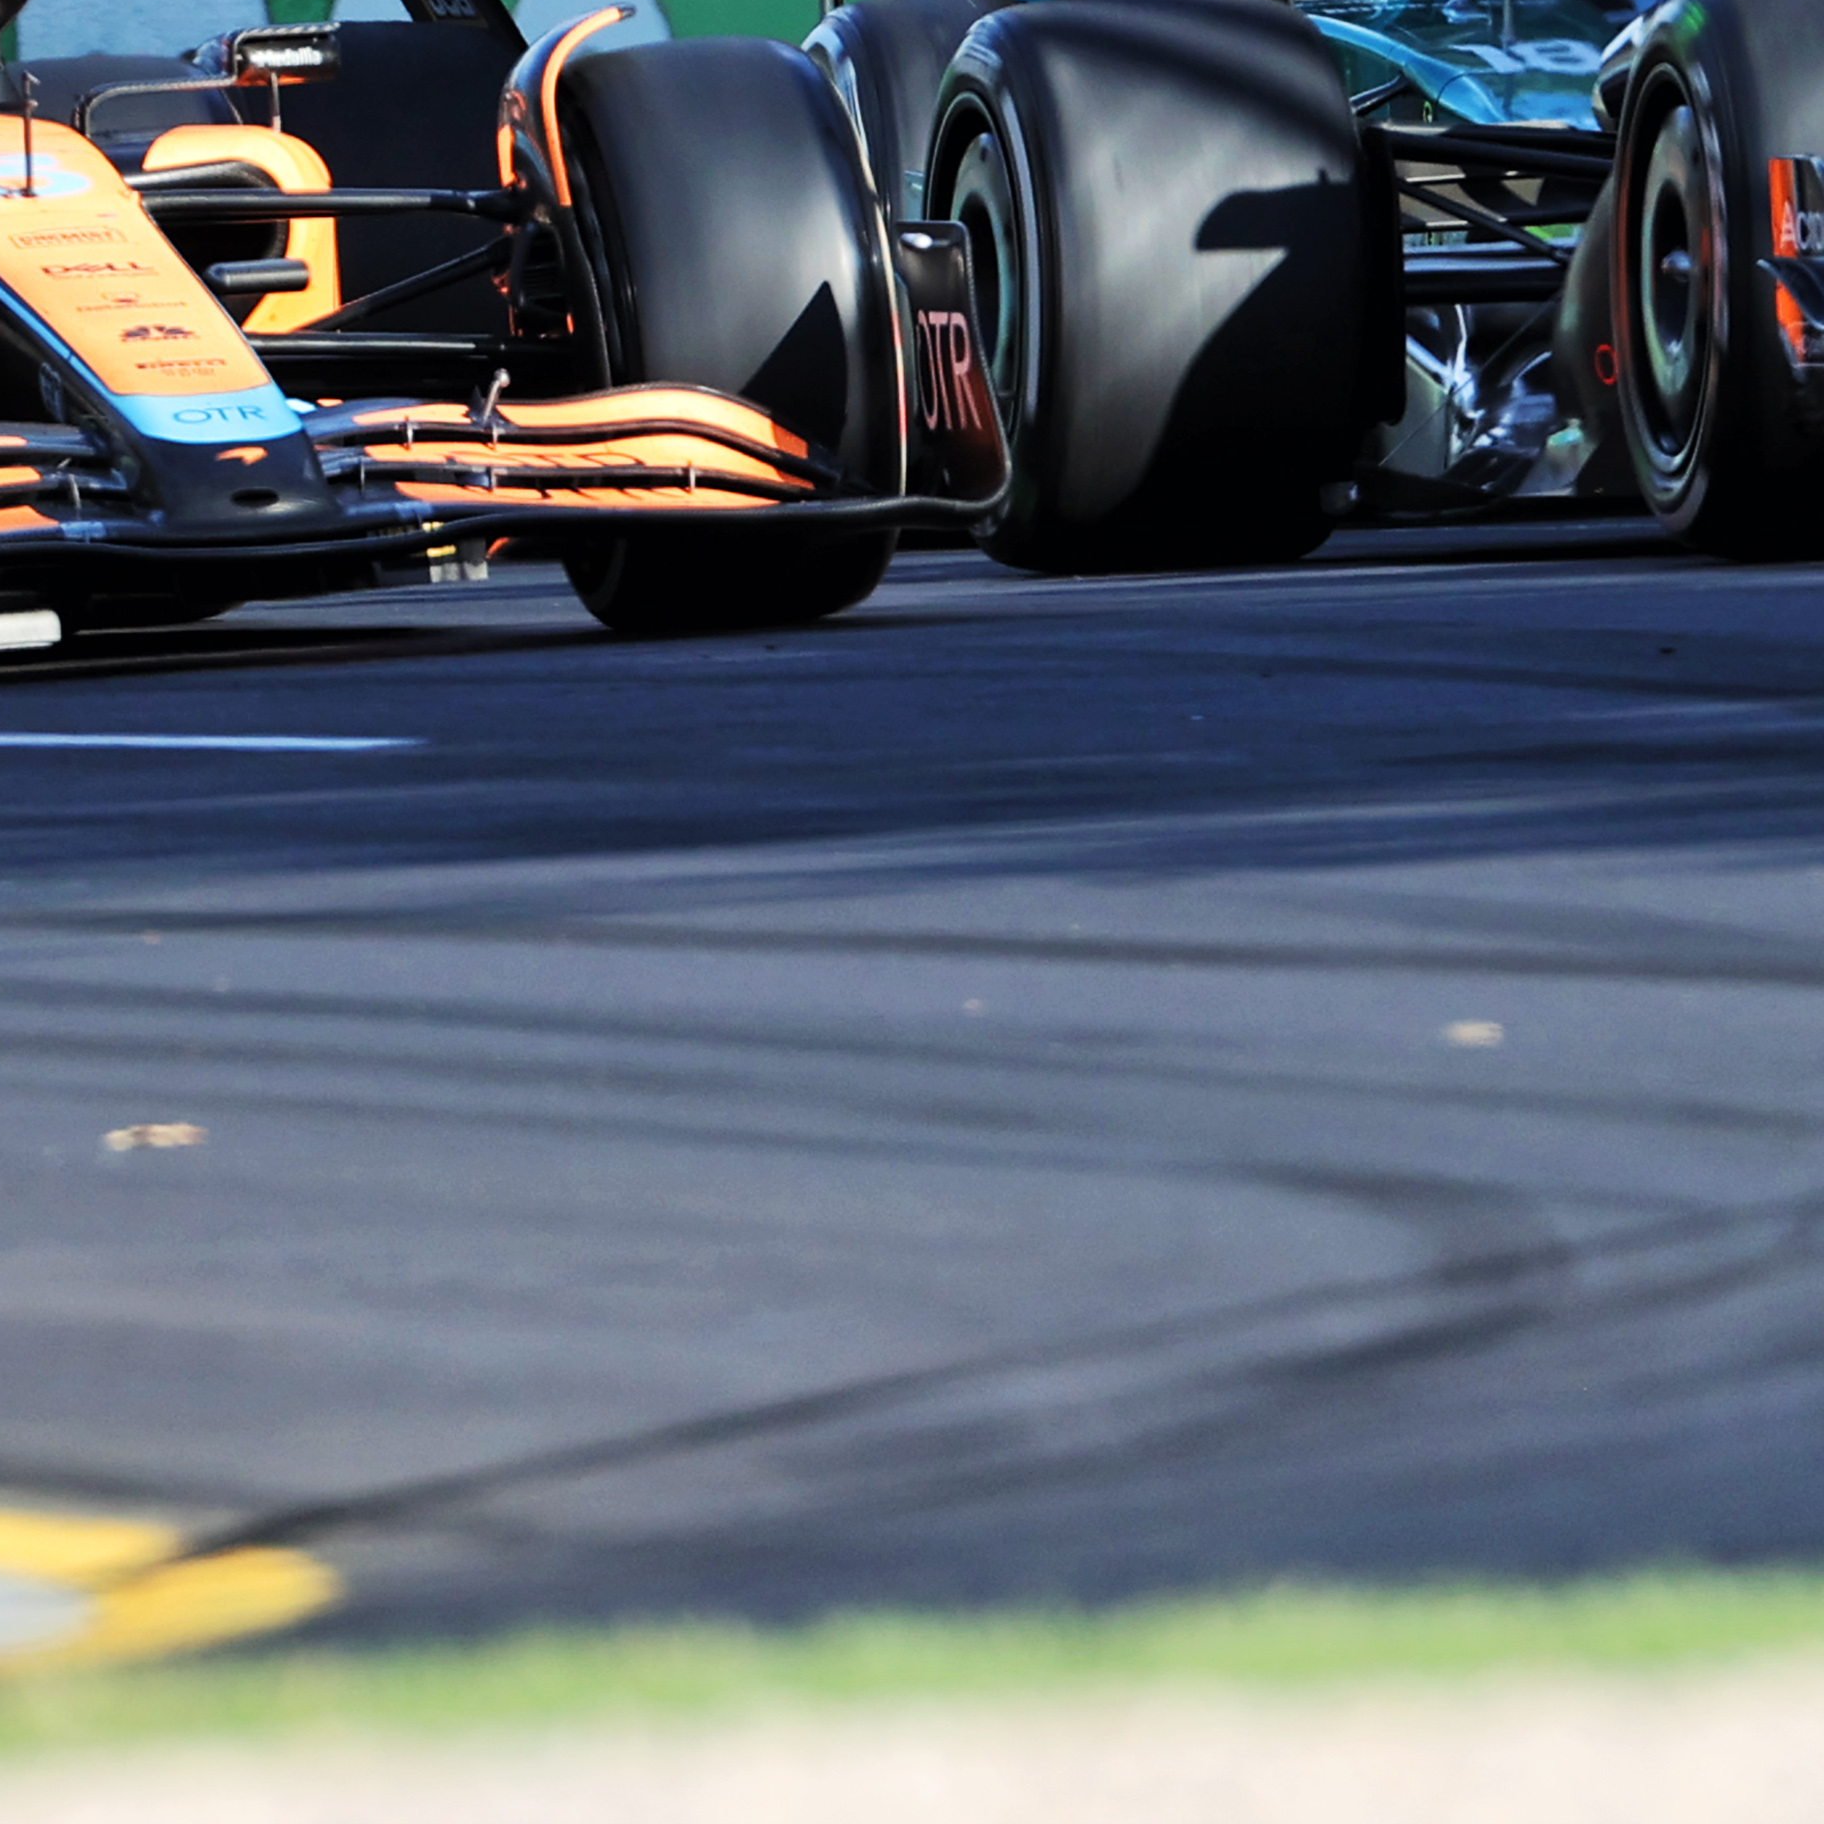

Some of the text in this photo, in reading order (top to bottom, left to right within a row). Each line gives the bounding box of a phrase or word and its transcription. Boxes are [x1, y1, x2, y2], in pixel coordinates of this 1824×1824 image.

[1448, 38, 1603, 75] 18
[917, 309, 982, 430] OTR
[173, 405, 268, 424] OTR
